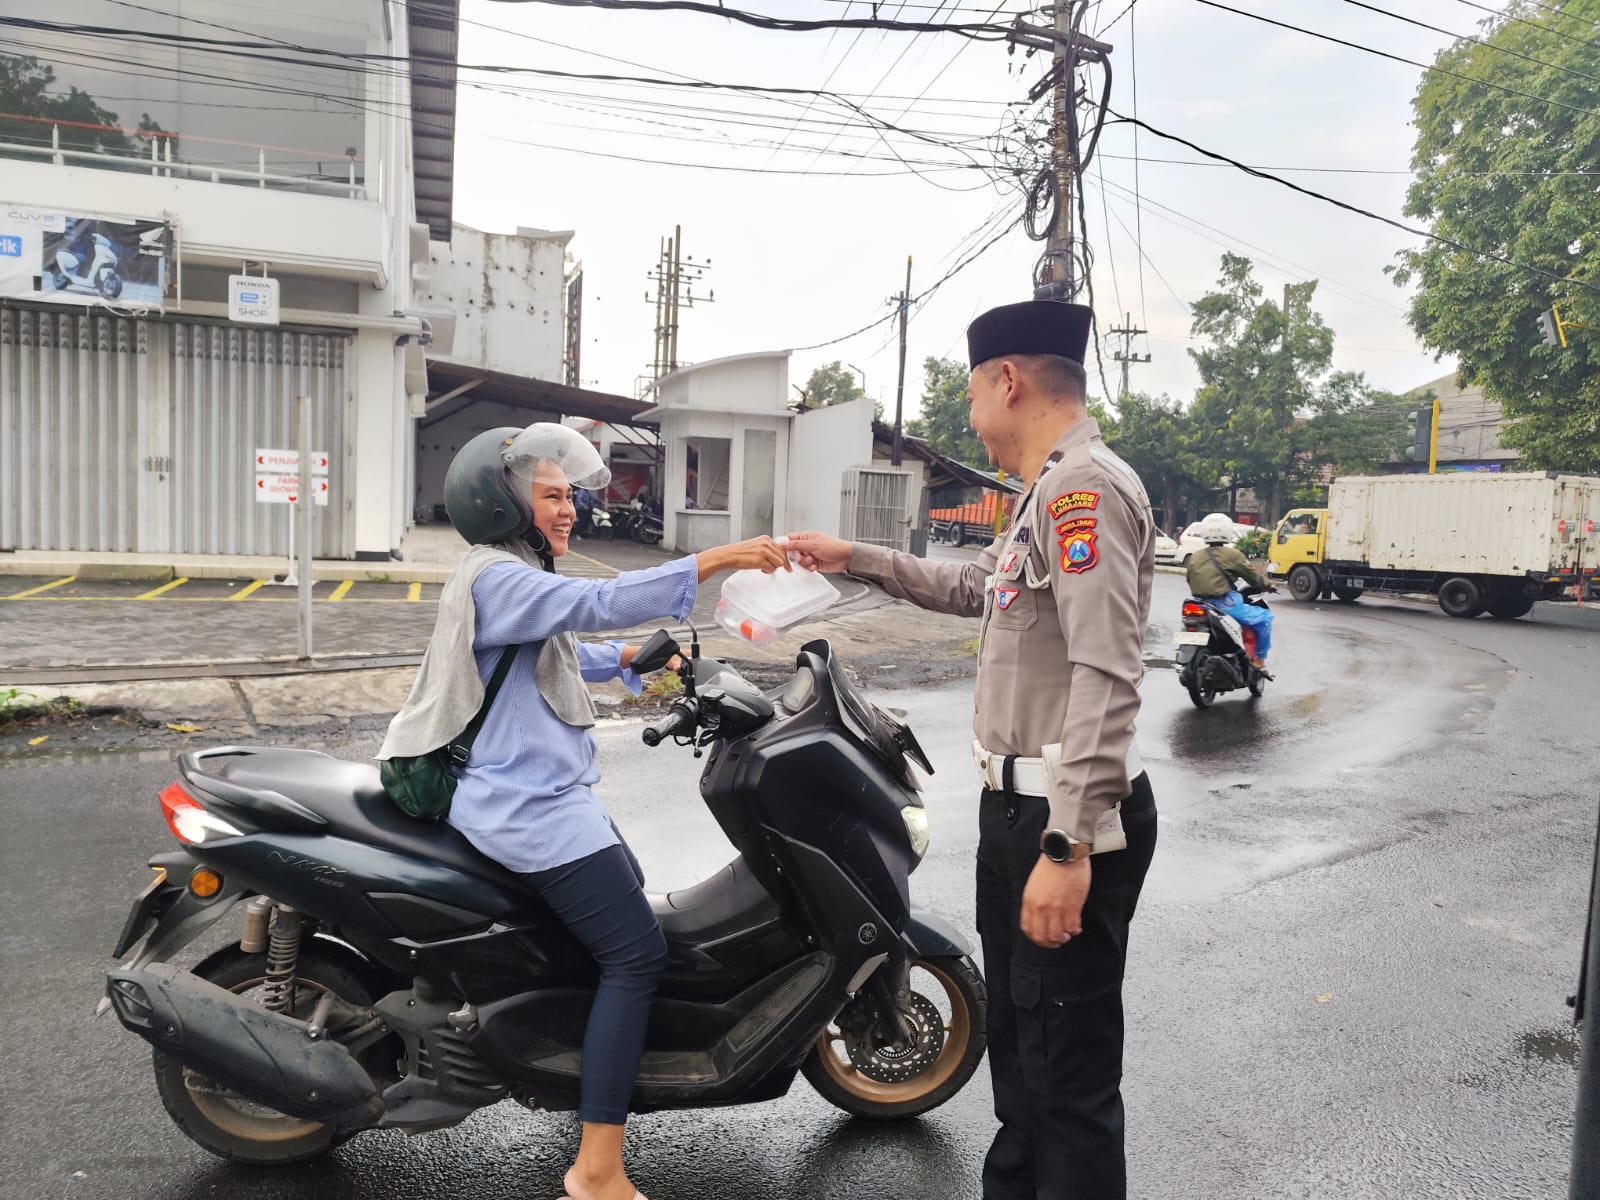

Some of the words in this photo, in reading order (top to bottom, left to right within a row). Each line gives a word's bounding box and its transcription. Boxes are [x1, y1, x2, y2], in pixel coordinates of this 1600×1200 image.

[236, 281, 271, 289] HONDA
[238, 307, 268, 317] SHOP
[1050, 493, 1095, 511] POLRES
